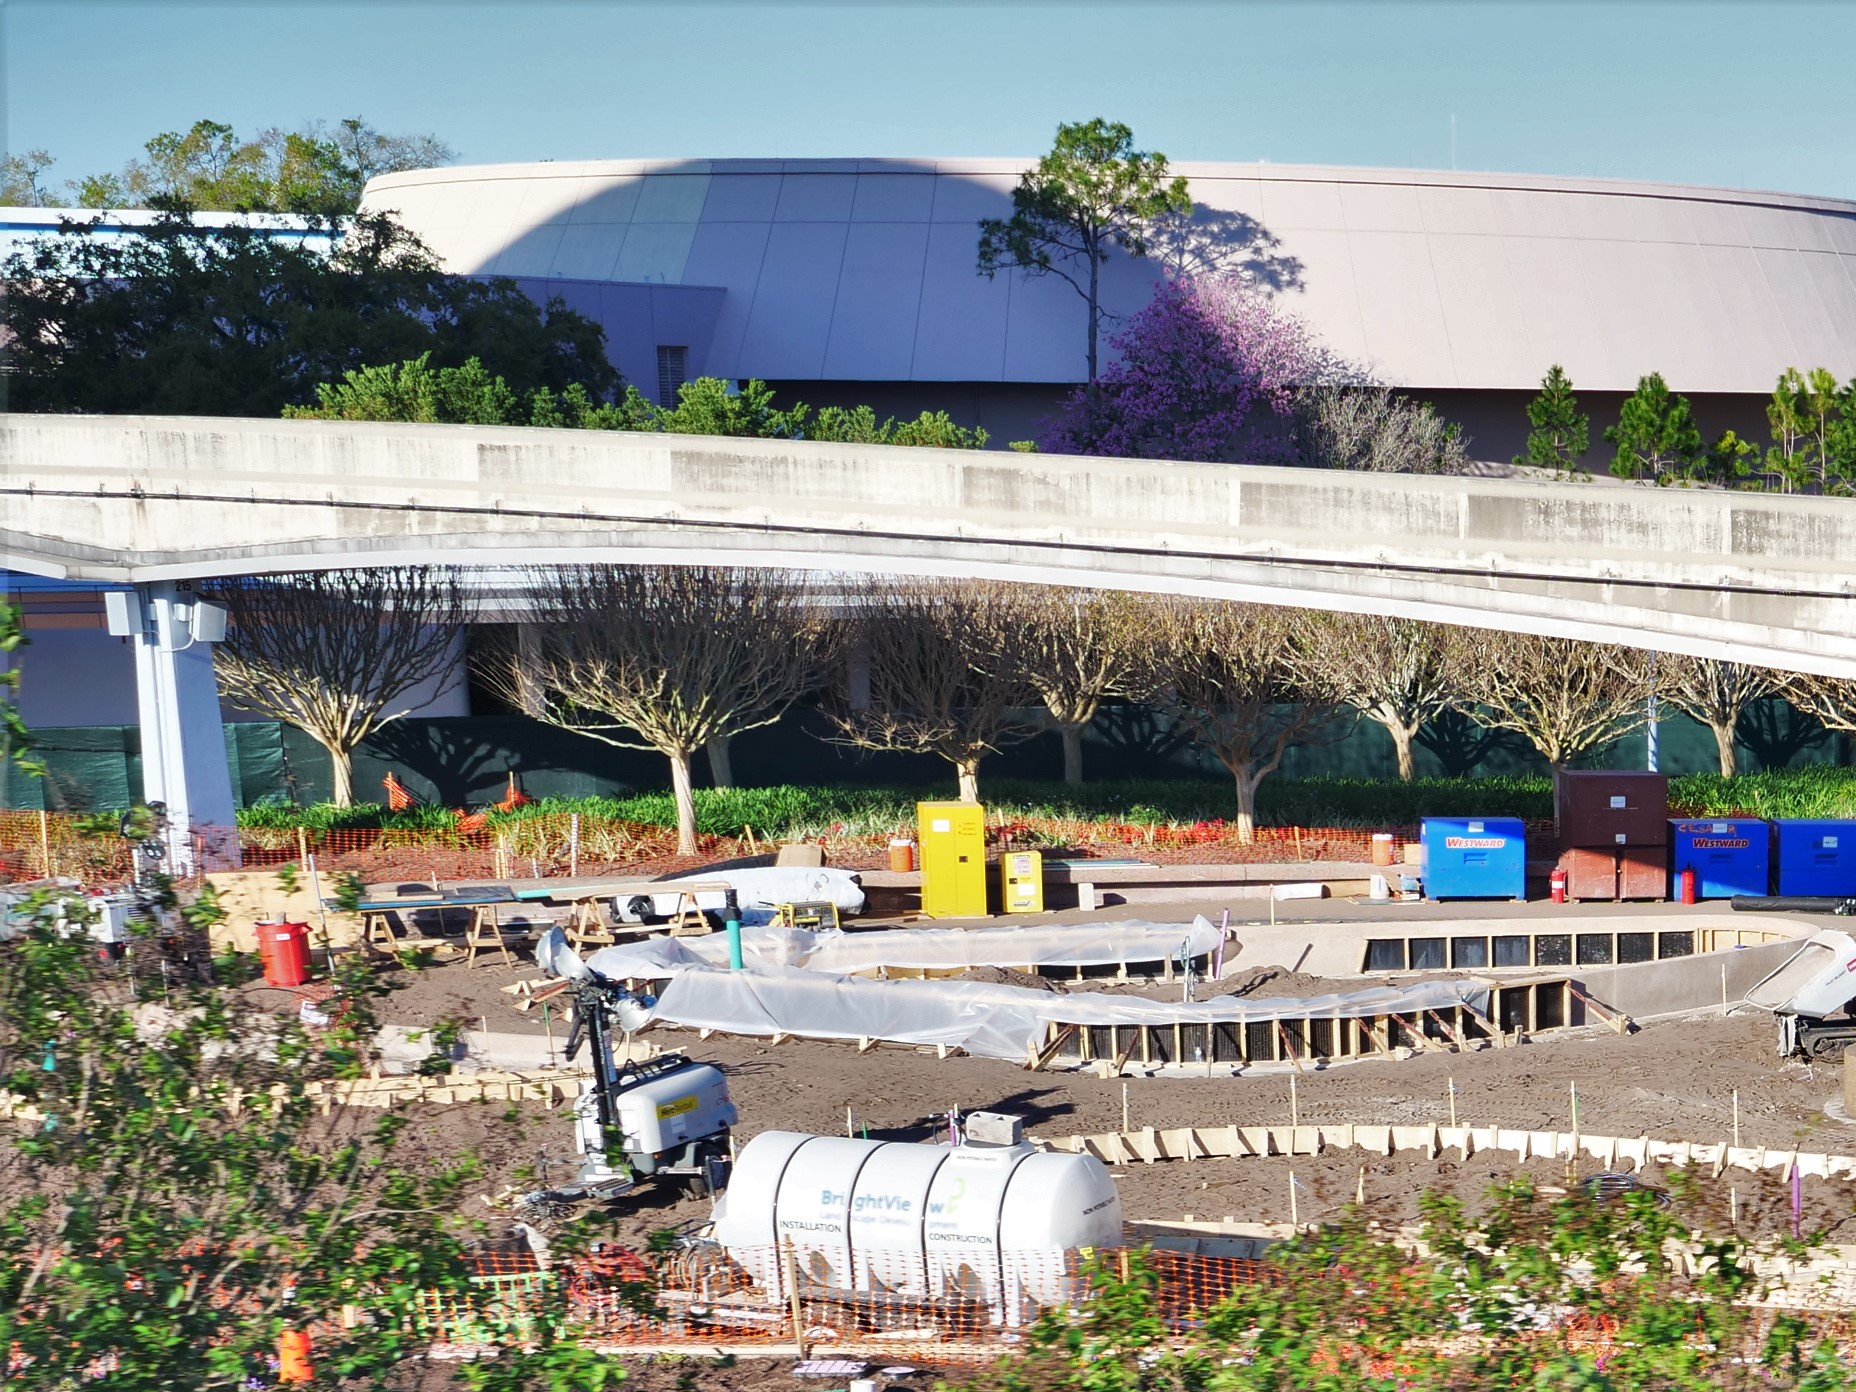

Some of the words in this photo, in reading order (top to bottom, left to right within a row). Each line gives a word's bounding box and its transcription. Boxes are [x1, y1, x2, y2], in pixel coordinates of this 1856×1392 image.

[175, 580, 192, 592] 215
[779, 1219, 842, 1233] INSTALLATION
[929, 1232, 993, 1244] CONSTRUCTION
